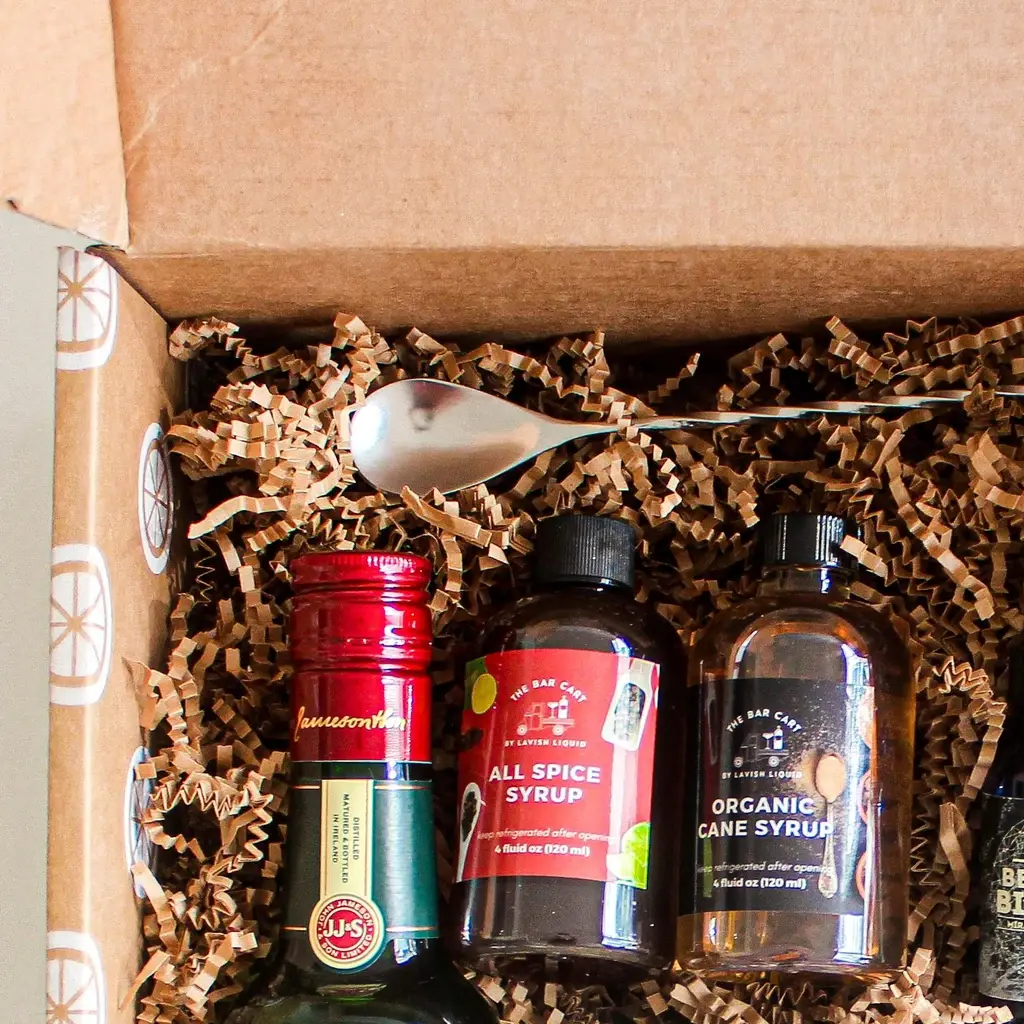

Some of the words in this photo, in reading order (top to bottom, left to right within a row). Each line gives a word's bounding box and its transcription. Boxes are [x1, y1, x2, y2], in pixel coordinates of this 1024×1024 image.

[510, 684, 529, 702] THE
[532, 678, 556, 689] BAR
[560, 681, 588, 703] CART
[726, 715, 744, 733] THE
[747, 708, 770, 719] BAR
[774, 711, 802, 733] CART
[504, 740, 515, 748] BY
[517, 739, 550, 747] LAVISH
[552, 739, 588, 748] LIQUID
[489, 764, 525, 782] ALL
[531, 763, 601, 783] SPICE
[721, 772, 731, 780] BY
[734, 770, 766, 778] LAVISH
[768, 771, 803, 779] LIQUID
[505, 786, 583, 804] SYRUP
[342, 793, 350, 835] MATURED
[712, 797, 815, 815] ORGANIC
[333, 814, 339, 823] IN
[495, 828, 550, 840] refrigerated
[551, 828, 577, 838] after
[698, 821, 748, 838] CANE
[754, 819, 834, 839] SYRUP
[352, 817, 360, 861] DISTILLED
[494, 845, 501, 854] 4
[502, 843, 527, 853] fluid
[544, 844, 569, 855] (120
[569, 846, 591, 857] ml)
[341, 844, 349, 884] BOTTLED
[767, 861, 791, 871] after
[713, 879, 720, 888] 4
[720, 877, 743, 888] fluid
[745, 879, 760, 887] oz
[760, 878, 784, 889] (120
[785, 879, 807, 889] ml)
[317, 903, 335, 927] JOHN
[336, 900, 374, 927] JAMESON
[321, 942, 339, 957] SON
[340, 934, 373, 959] LIMITED
